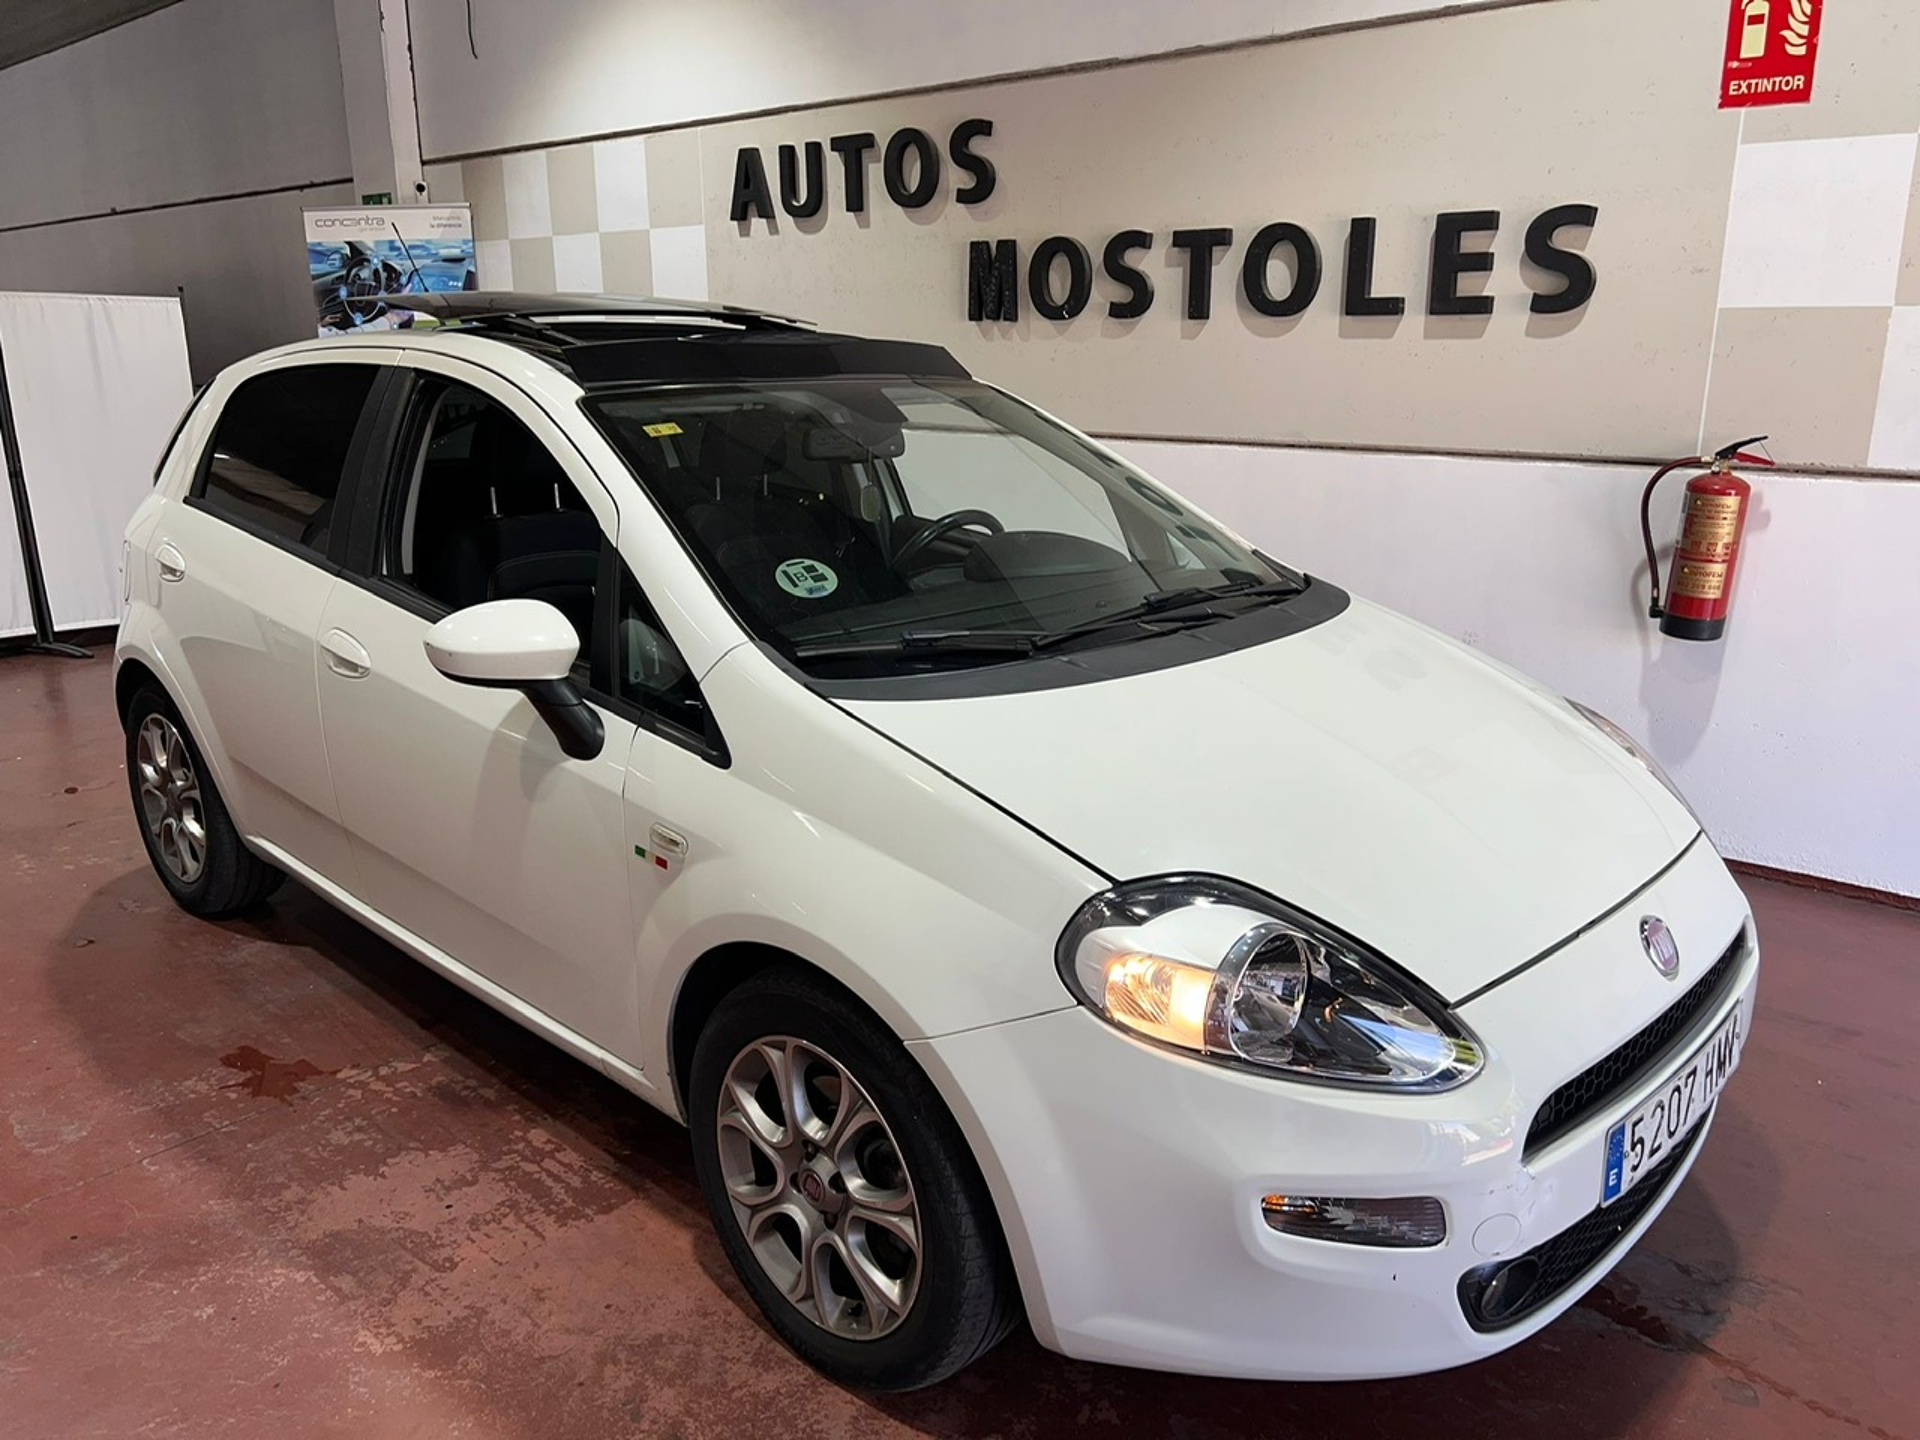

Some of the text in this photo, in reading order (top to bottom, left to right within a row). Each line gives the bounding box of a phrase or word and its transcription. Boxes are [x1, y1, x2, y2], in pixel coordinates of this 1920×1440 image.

[1728, 75, 1805, 95] EXTINTOR
[314, 214, 385, 228] concentra
[730, 118, 996, 221] AUTOS
[968, 203, 1599, 322] MOSTOLES
[1608, 1168, 1619, 1186] E
[1629, 1065, 1698, 1173] 5207
